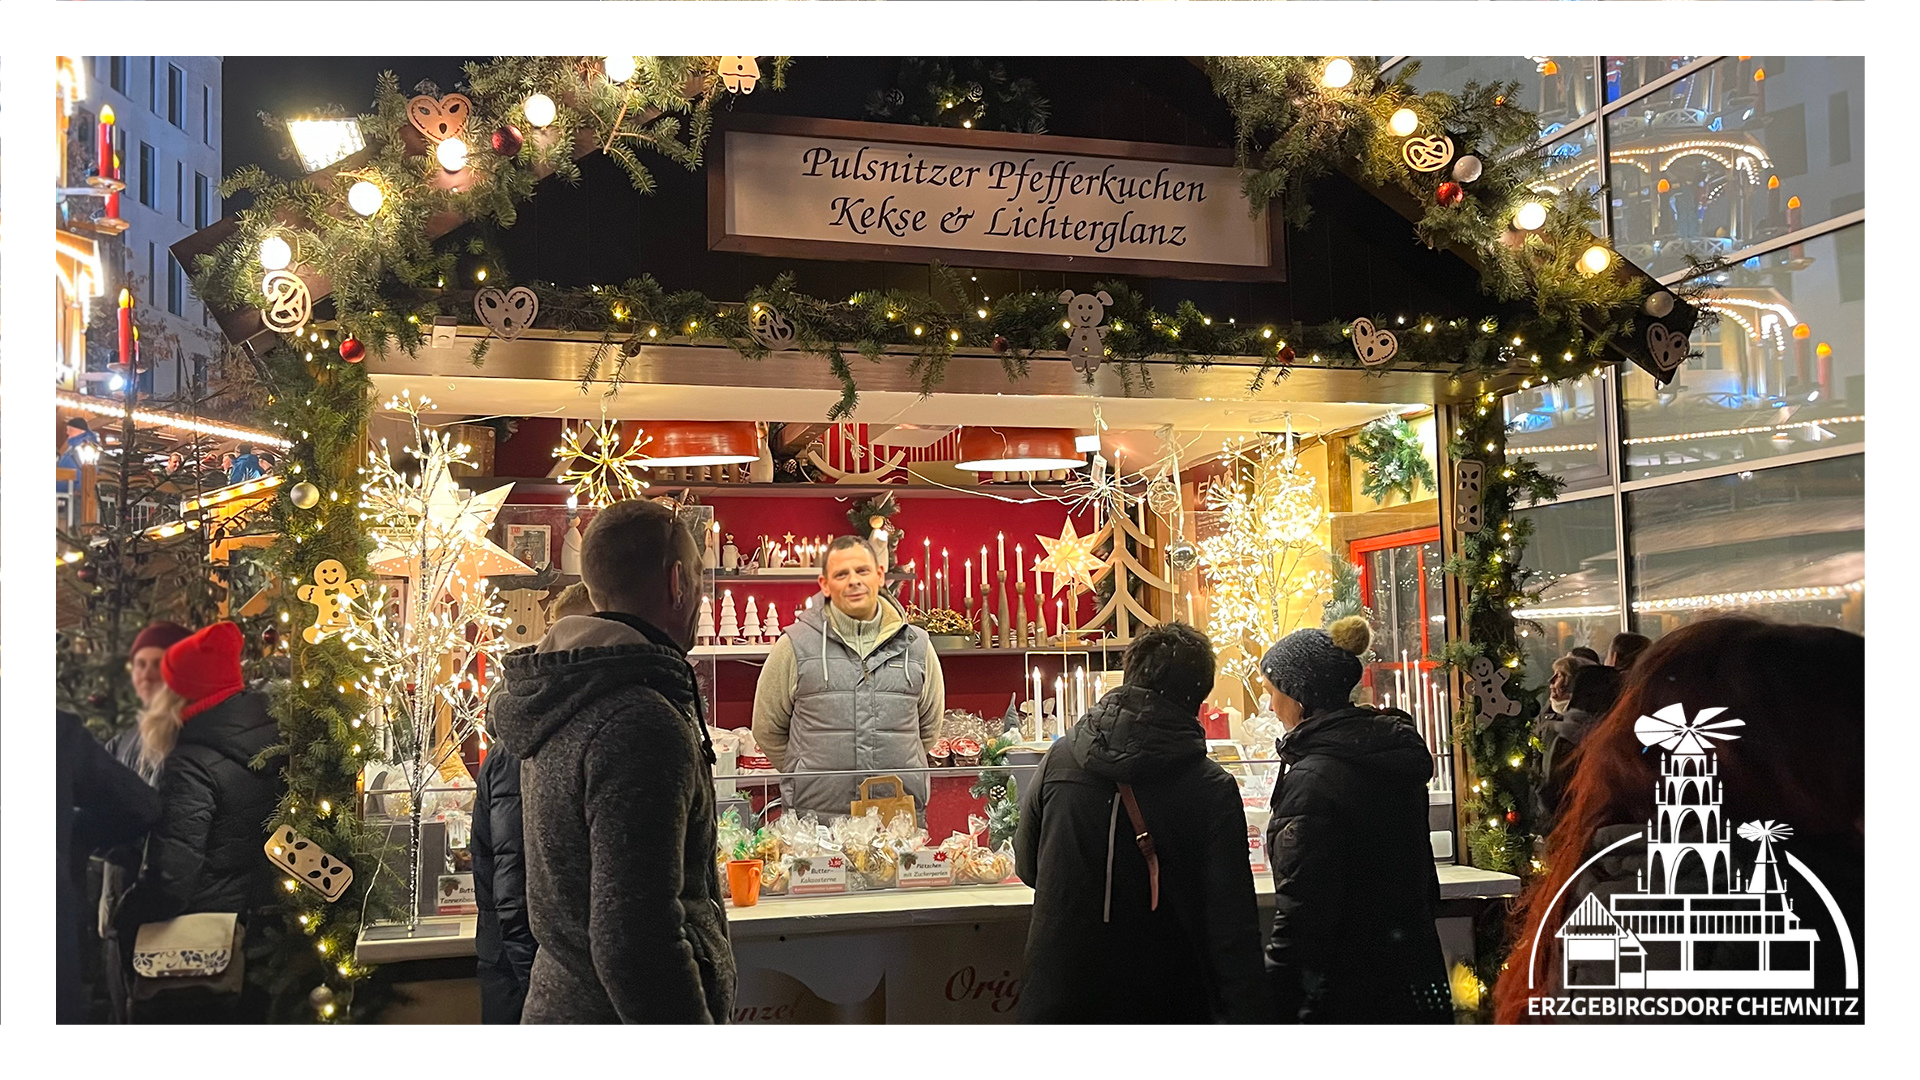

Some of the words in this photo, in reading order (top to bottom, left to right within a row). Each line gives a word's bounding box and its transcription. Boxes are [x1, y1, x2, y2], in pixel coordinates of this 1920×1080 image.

[802, 146, 981, 188] Pulsnitzer
[988, 158, 1208, 204] Pfefferkuchen
[829, 195, 928, 237] Kekse
[939, 206, 976, 234] &
[984, 206, 1187, 253] Lichterglanz
